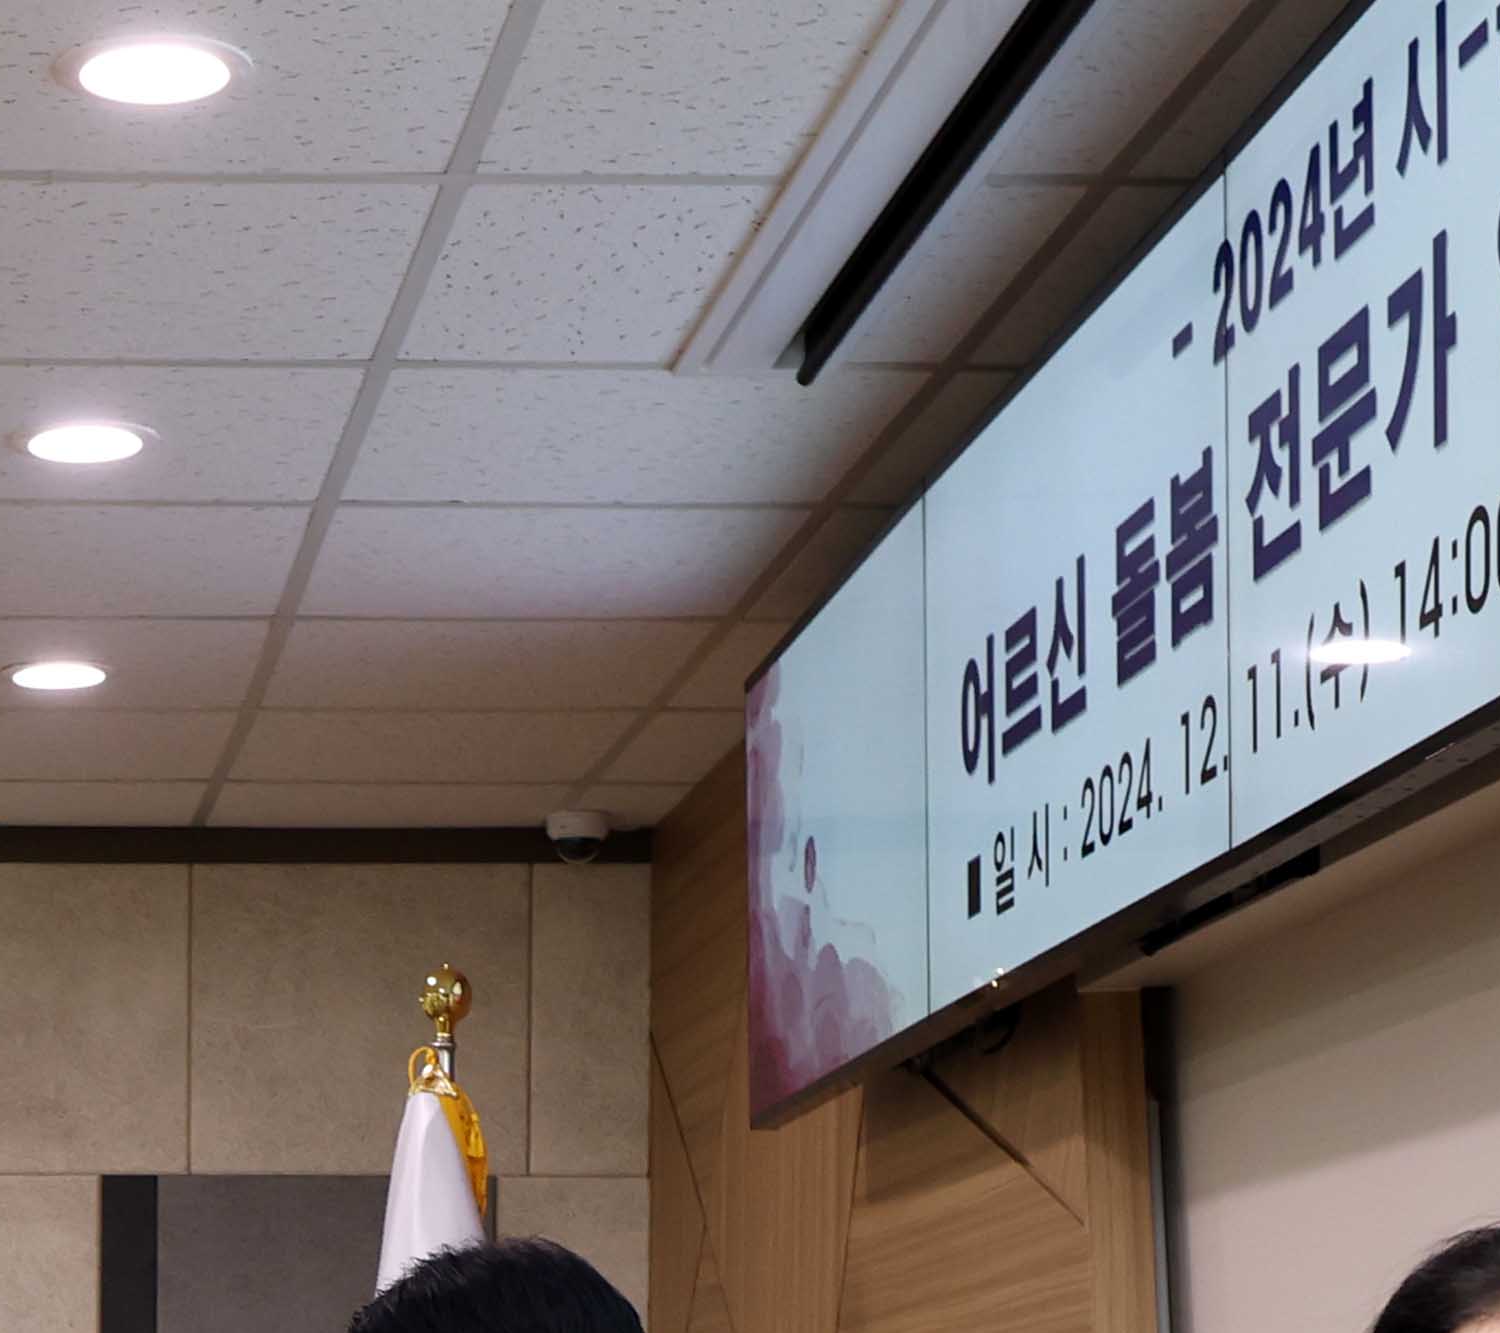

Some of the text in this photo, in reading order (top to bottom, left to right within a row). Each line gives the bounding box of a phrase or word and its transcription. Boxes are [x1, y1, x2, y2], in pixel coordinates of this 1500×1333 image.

[1211, 75, 1376, 365] 2024년
[960, 553, 1088, 786] 어르신
[1111, 444, 1219, 688] 돌봄
[1244, 228, 1458, 583] 전문가
[1080, 736, 1165, 860] 2024.
[1180, 694, 1230, 796] 12.
